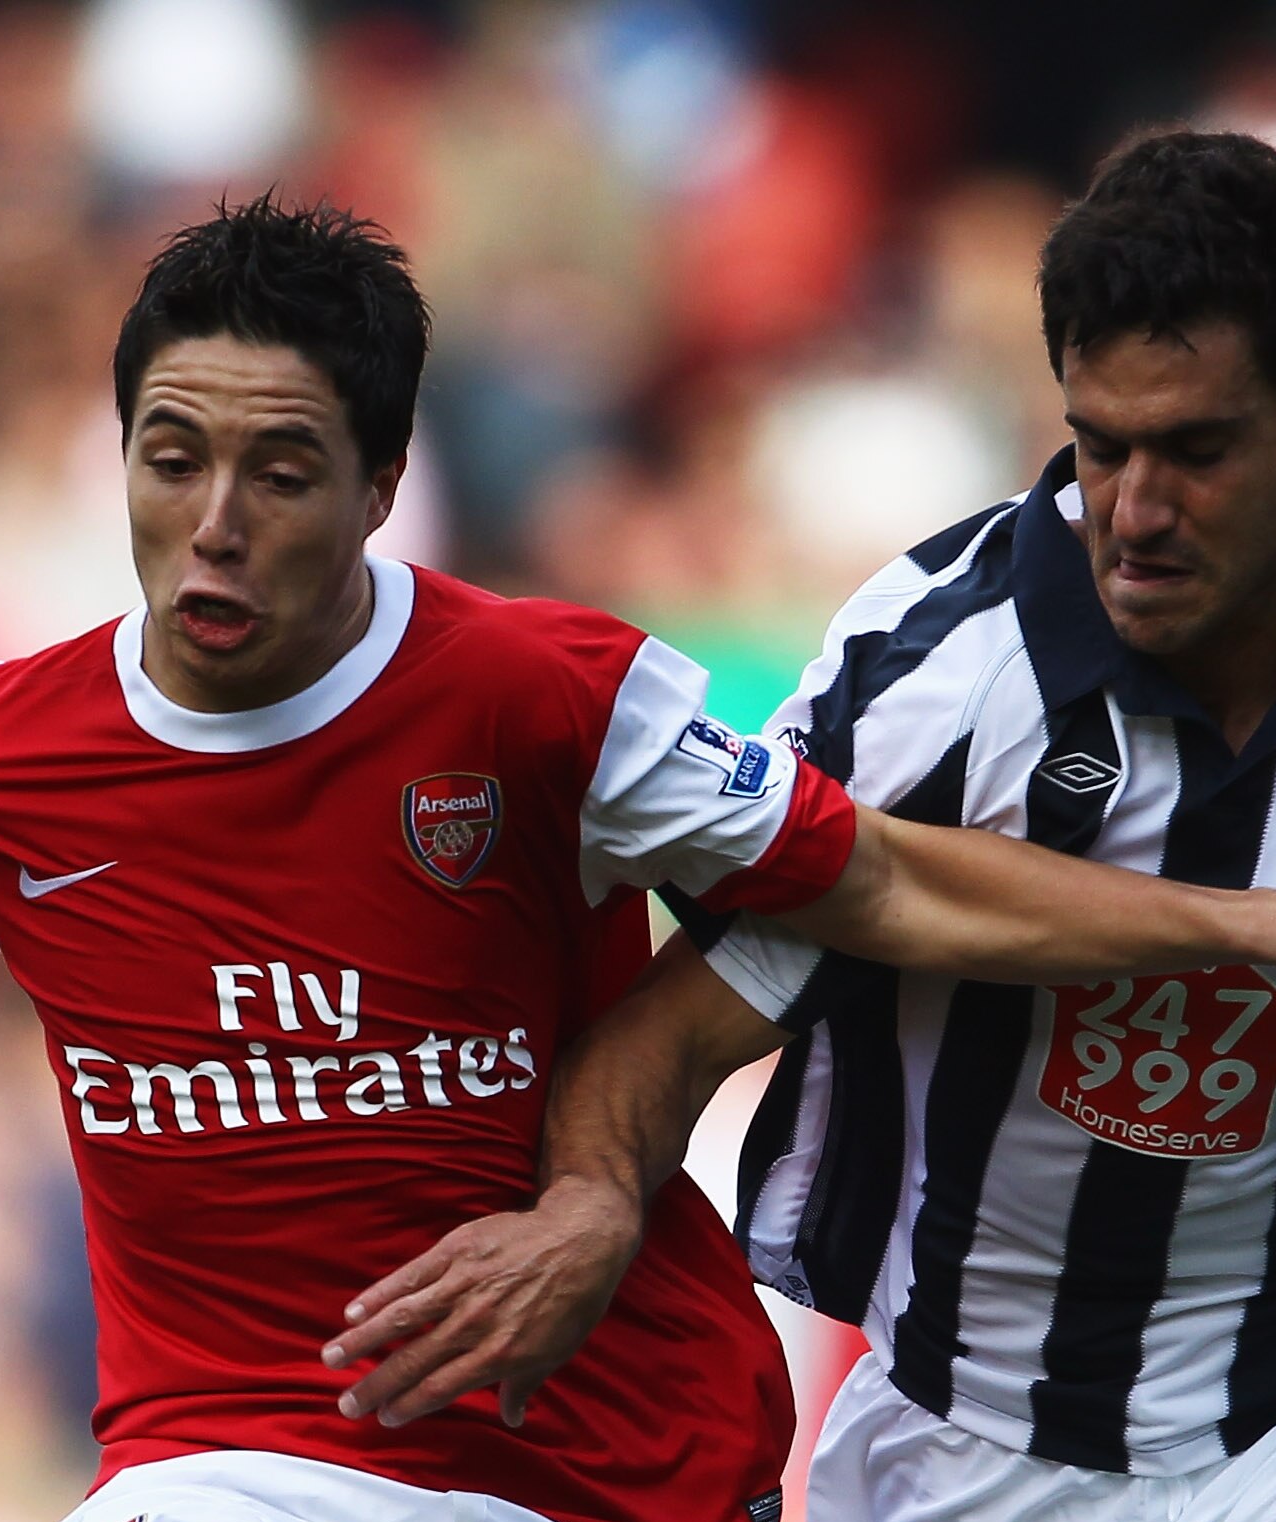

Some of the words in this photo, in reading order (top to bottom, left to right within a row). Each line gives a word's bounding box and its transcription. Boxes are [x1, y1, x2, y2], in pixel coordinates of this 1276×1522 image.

[417, 791, 487, 813] Arsenal
[210, 961, 360, 1041] Fly
[1077, 976, 1273, 1055] 247
[63, 1026, 537, 1136] Emirates
[1073, 1030, 1257, 1122] 999
[1060, 1086, 1241, 1151] HomeServe
